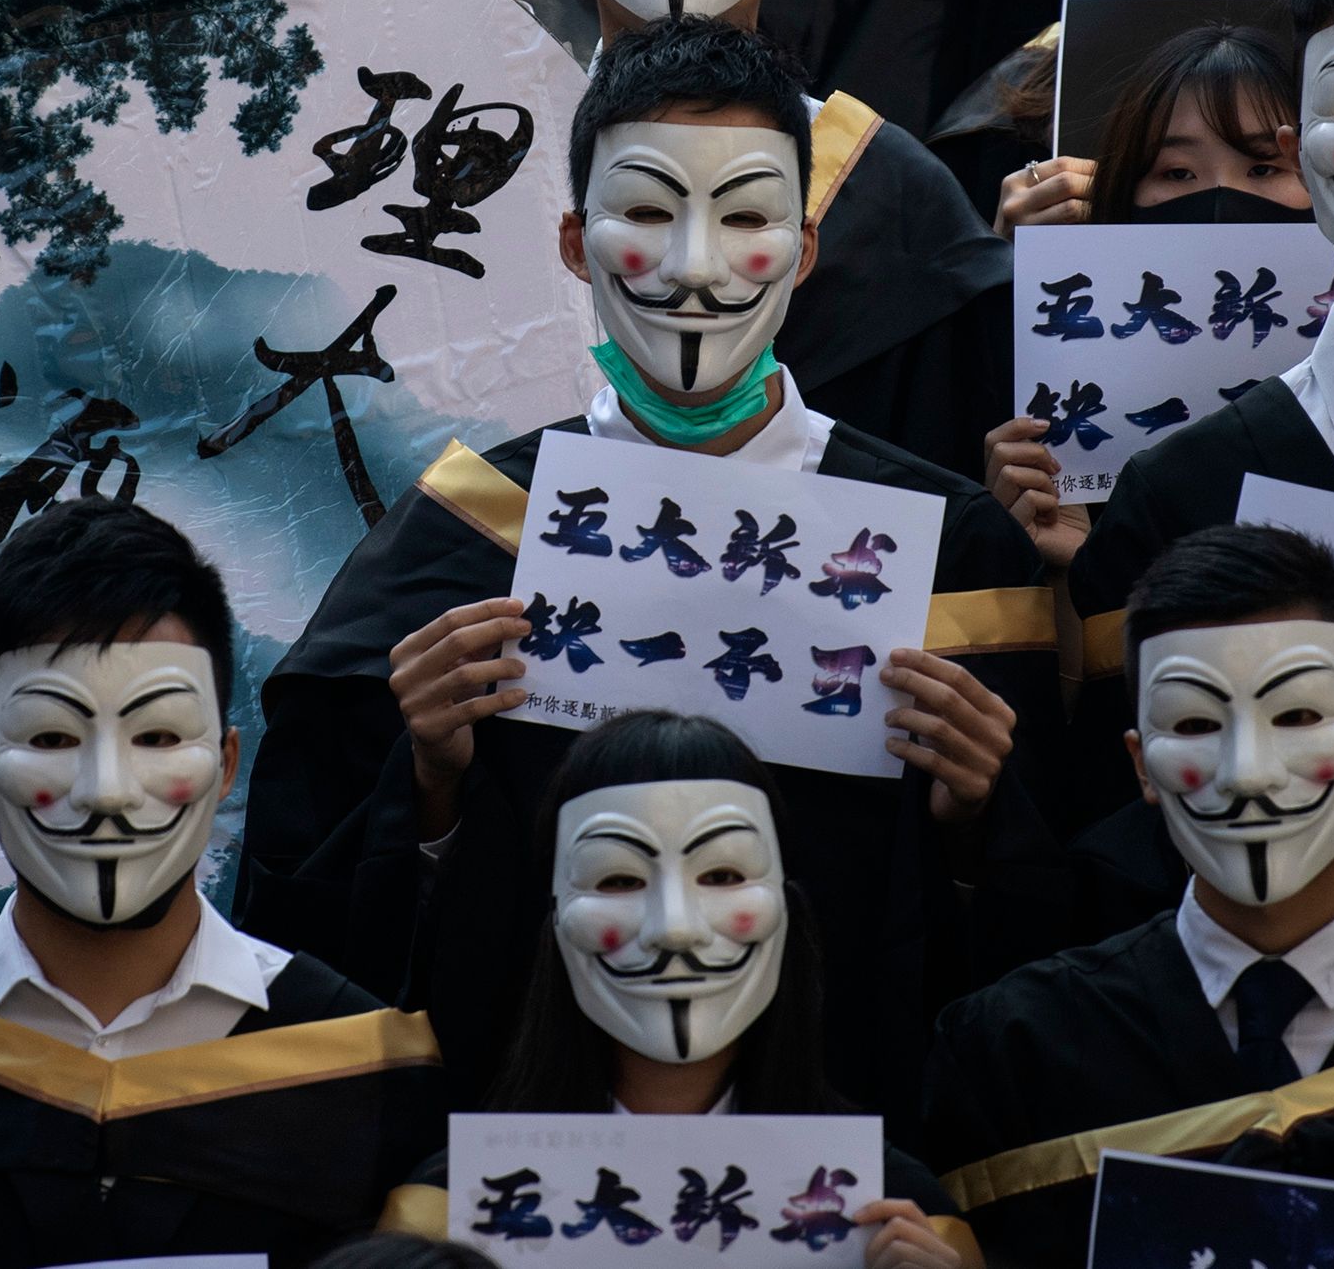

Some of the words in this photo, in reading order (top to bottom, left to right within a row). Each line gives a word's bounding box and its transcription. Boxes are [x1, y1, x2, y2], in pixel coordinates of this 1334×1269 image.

[1050, 473, 1121, 493] 你逐點
[540, 487, 897, 610] 五大訴求
[518, 591, 877, 718] 缺一不可
[526, 691, 632, 722] 和你逐點訴
[471, 1165, 860, 1252] 五大訴求
